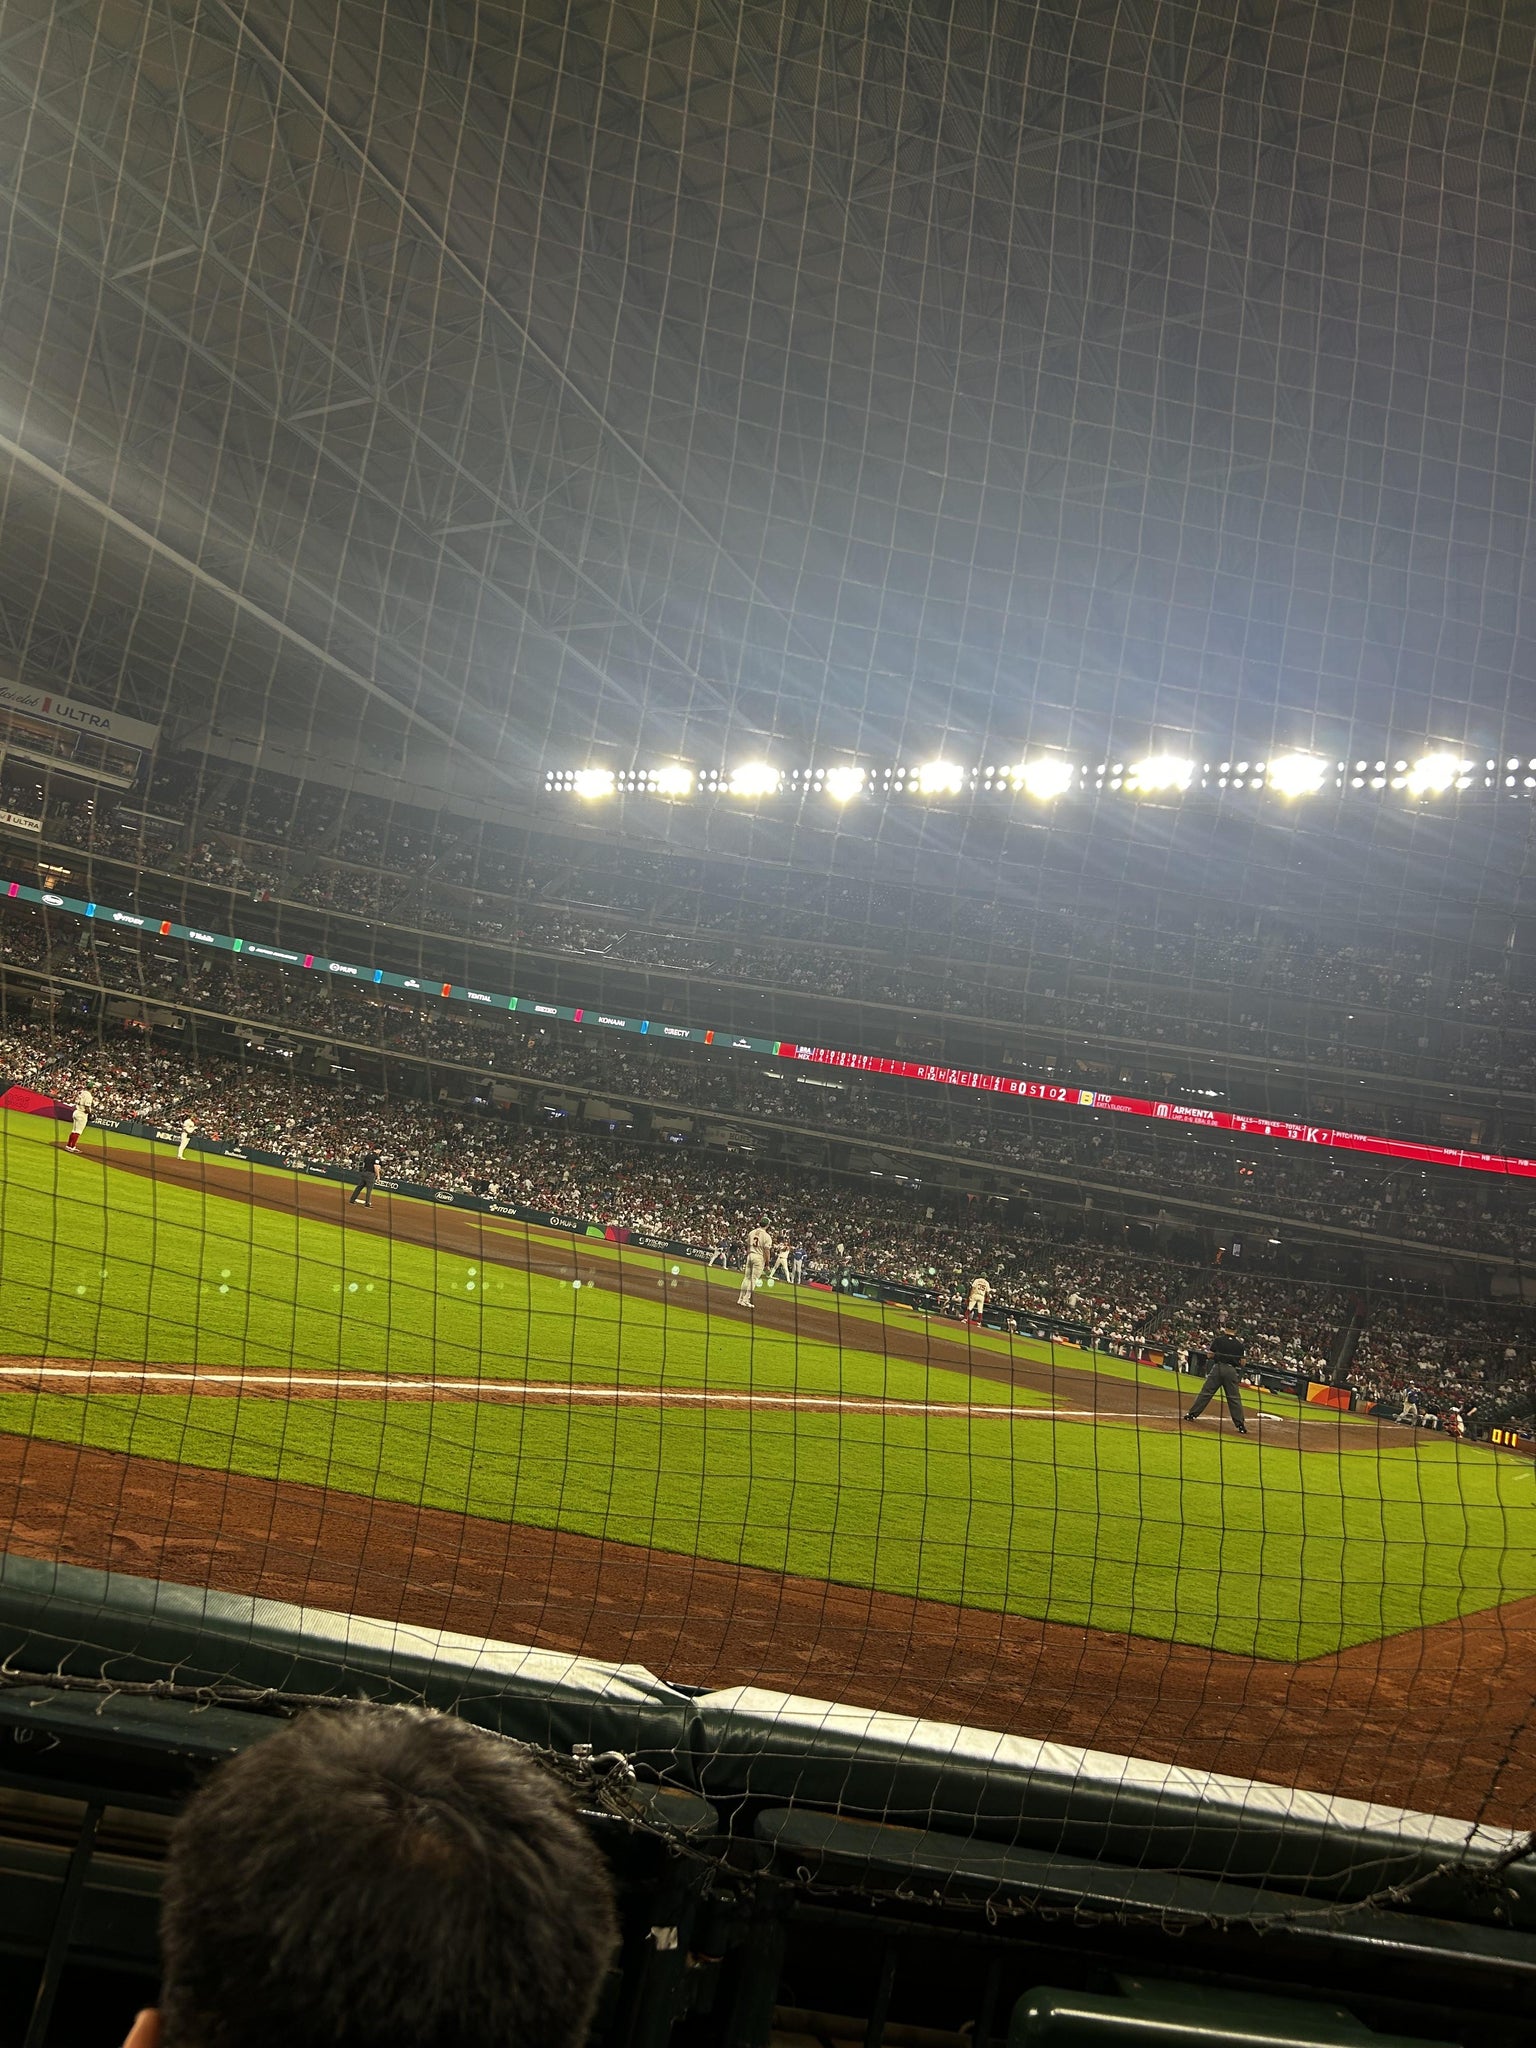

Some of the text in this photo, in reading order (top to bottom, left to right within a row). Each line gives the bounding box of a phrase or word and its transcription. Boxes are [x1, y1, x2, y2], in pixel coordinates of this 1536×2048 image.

[56, 703, 111, 729] ULTRA
[12, 817, 39, 830] ULTRA
[598, 1016, 626, 1027] KONAMI
[664, 1027, 690, 1038] DIRECTV
[918, 1067, 924, 1076] R
[939, 1071, 946, 1079] H
[961, 1074, 967, 1083] E
[1010, 1083, 1017, 1091] B
[1018, 1082, 1026, 1094] 0
[1030, 1086, 1036, 1095] S
[1040, 1086, 1045, 1098] 1
[1057, 1088, 1066, 1101] 2
[1098, 1094, 1111, 1103] ITO
[1172, 1106, 1214, 1119] ARMENTA
[1288, 1130, 1297, 1139] 13
[1306, 1128, 1319, 1143] K
[1353, 1133, 1367, 1142] TYPE
[752, 1236, 759, 1248] 3
